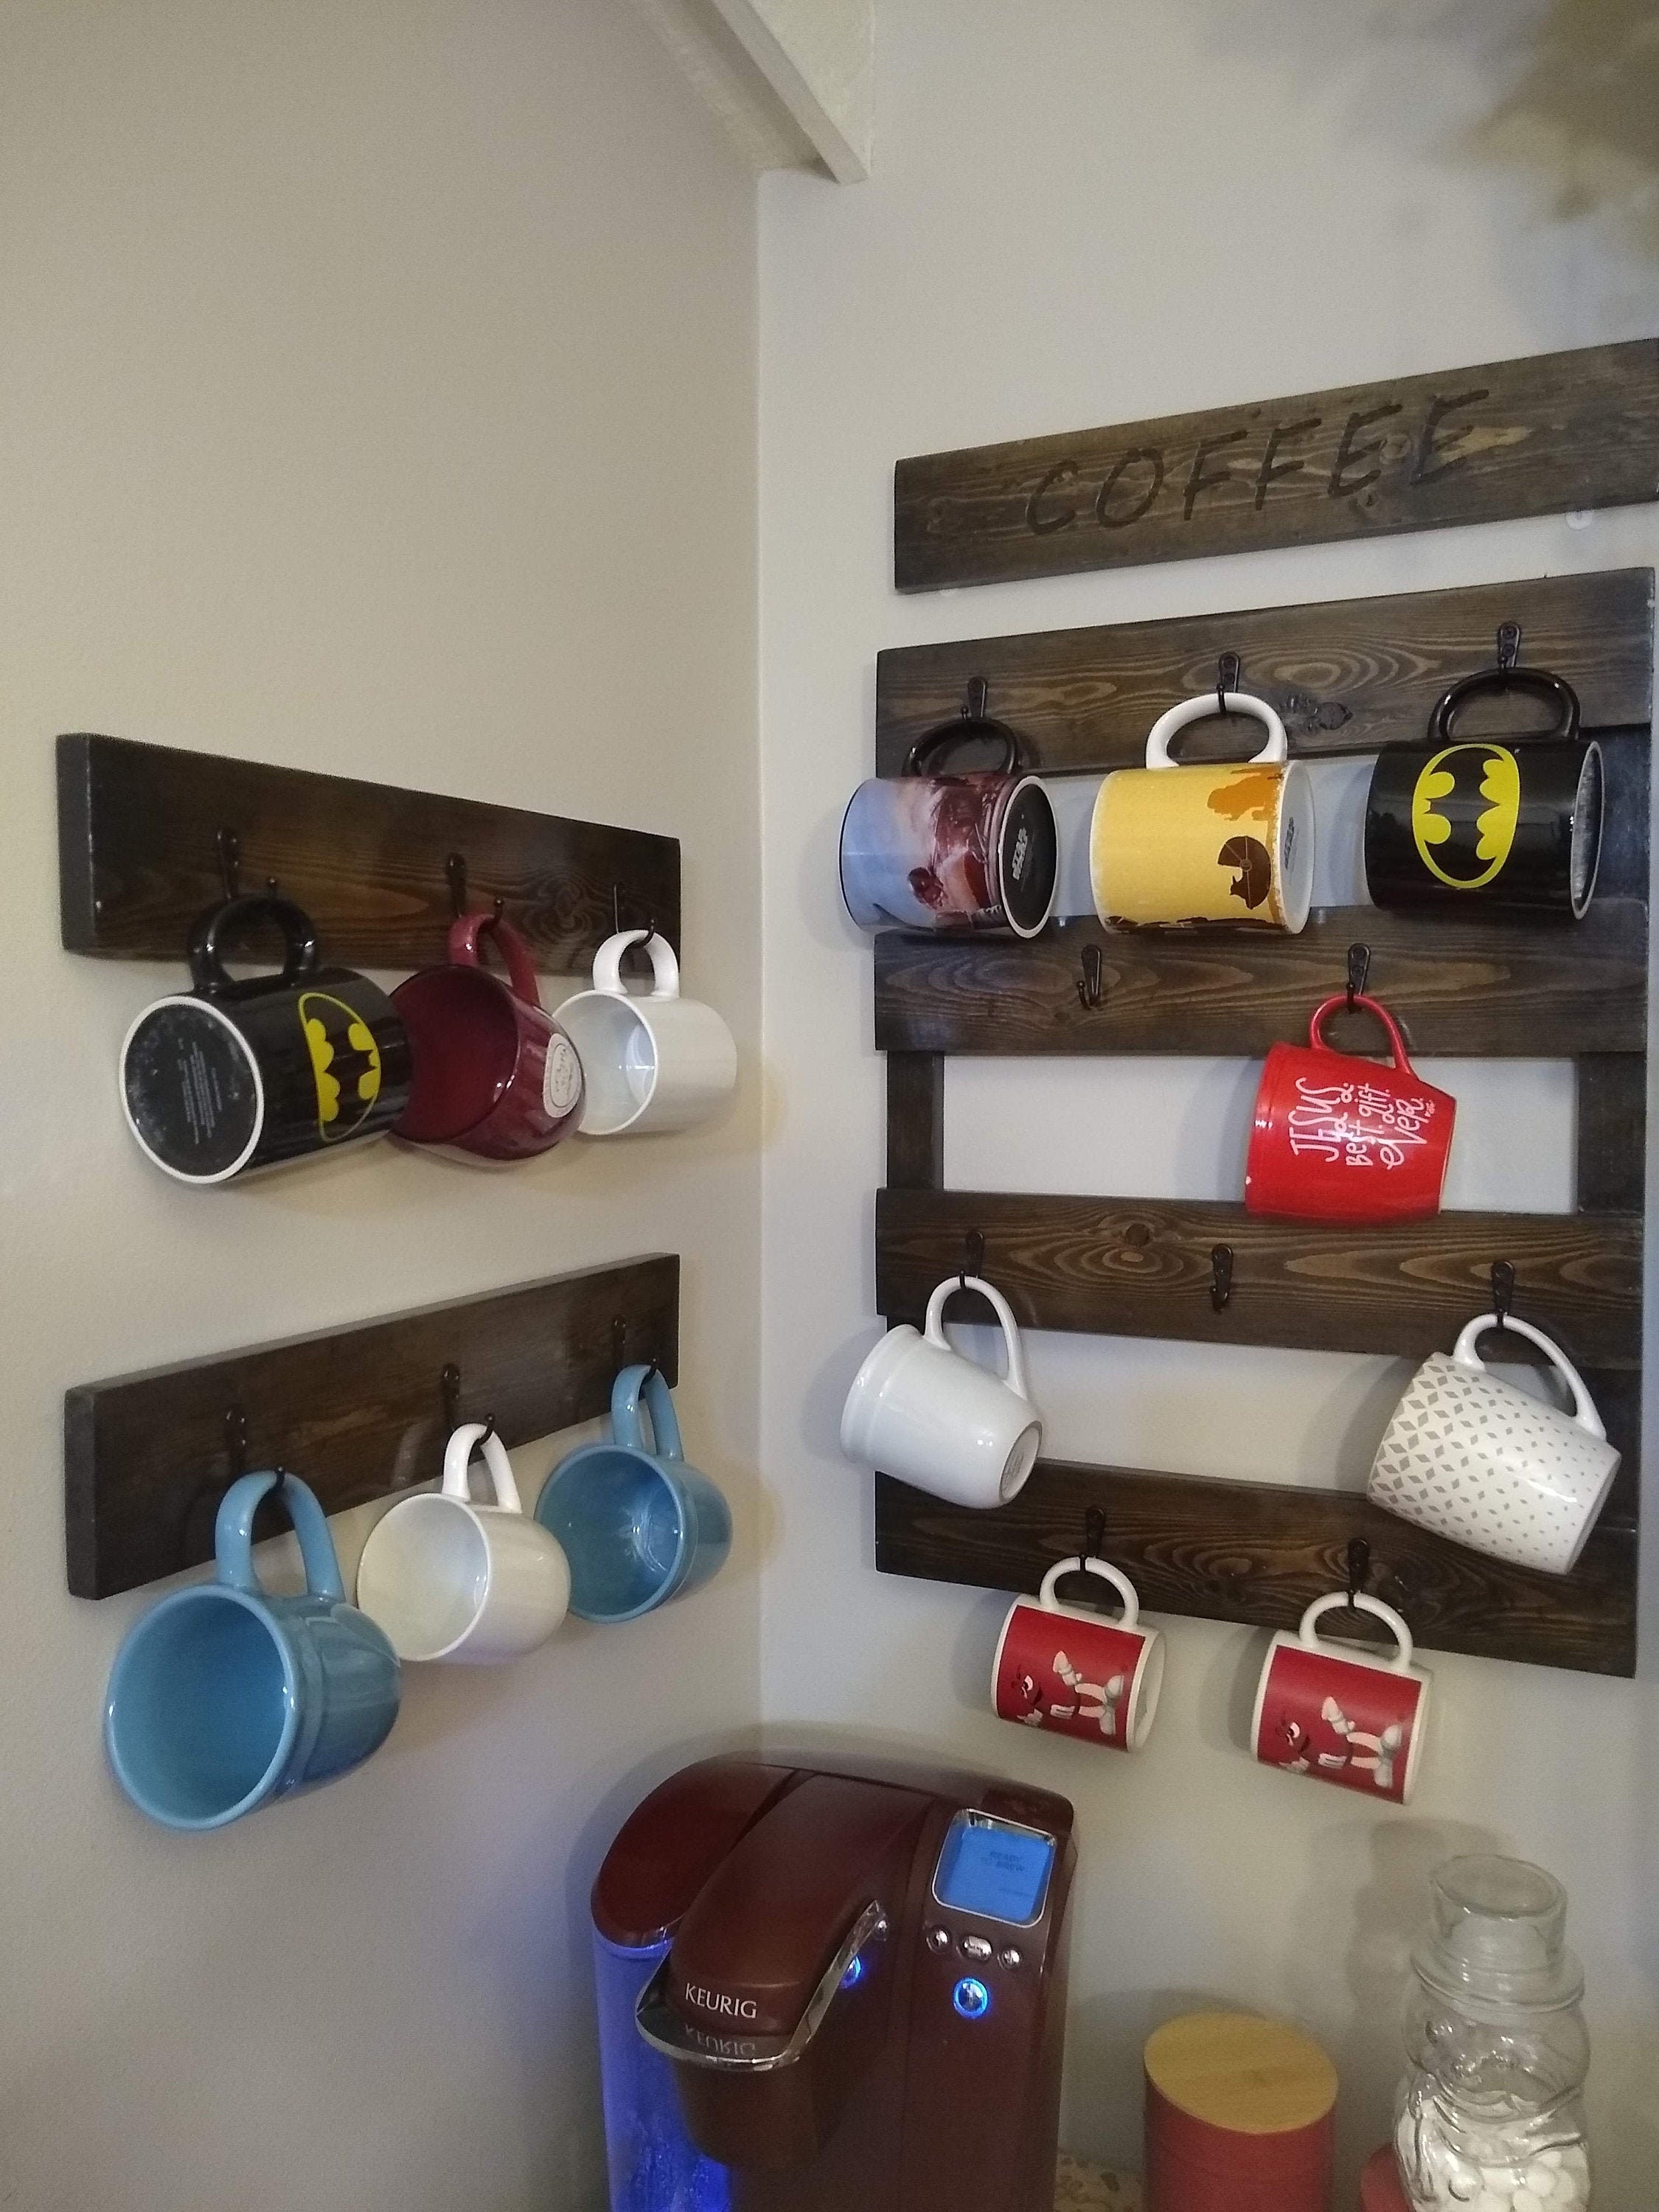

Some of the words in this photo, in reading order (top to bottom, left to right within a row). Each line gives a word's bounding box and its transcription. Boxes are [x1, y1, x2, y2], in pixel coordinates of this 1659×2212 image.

[1024, 389, 1489, 535] COFFEE
[1288, 1077, 1354, 1163] JESUS
[1354, 1083, 1396, 1124] gift
[684, 1982, 757, 2019] KEURIG
